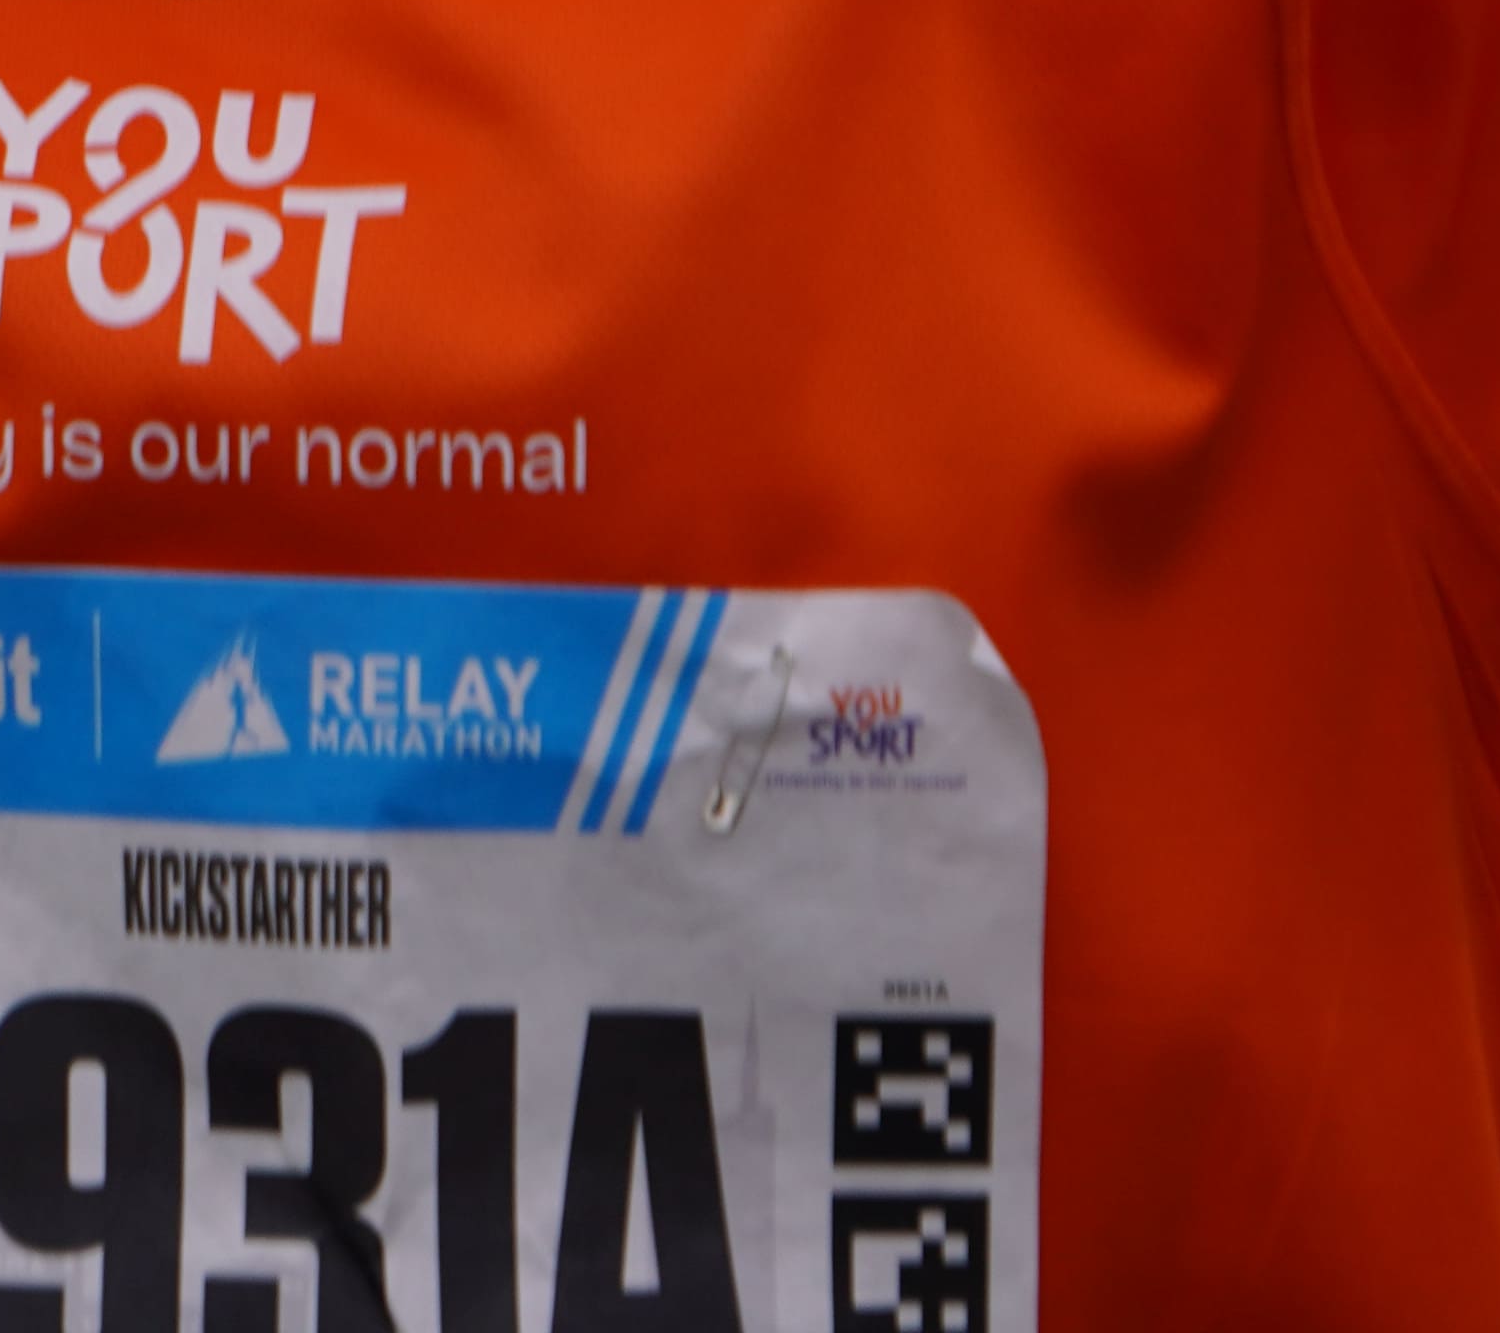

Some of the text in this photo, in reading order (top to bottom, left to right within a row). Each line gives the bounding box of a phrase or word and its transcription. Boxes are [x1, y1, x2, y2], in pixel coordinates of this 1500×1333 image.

[41, 403, 104, 482] is
[130, 418, 270, 483] our
[296, 417, 588, 494] normal
[309, 652, 541, 720] RELAY
[830, 685, 903, 728] YOU
[309, 718, 542, 762] MARATHON
[808, 713, 925, 765] SPORT
[121, 847, 392, 950] KICKSTARTHER
